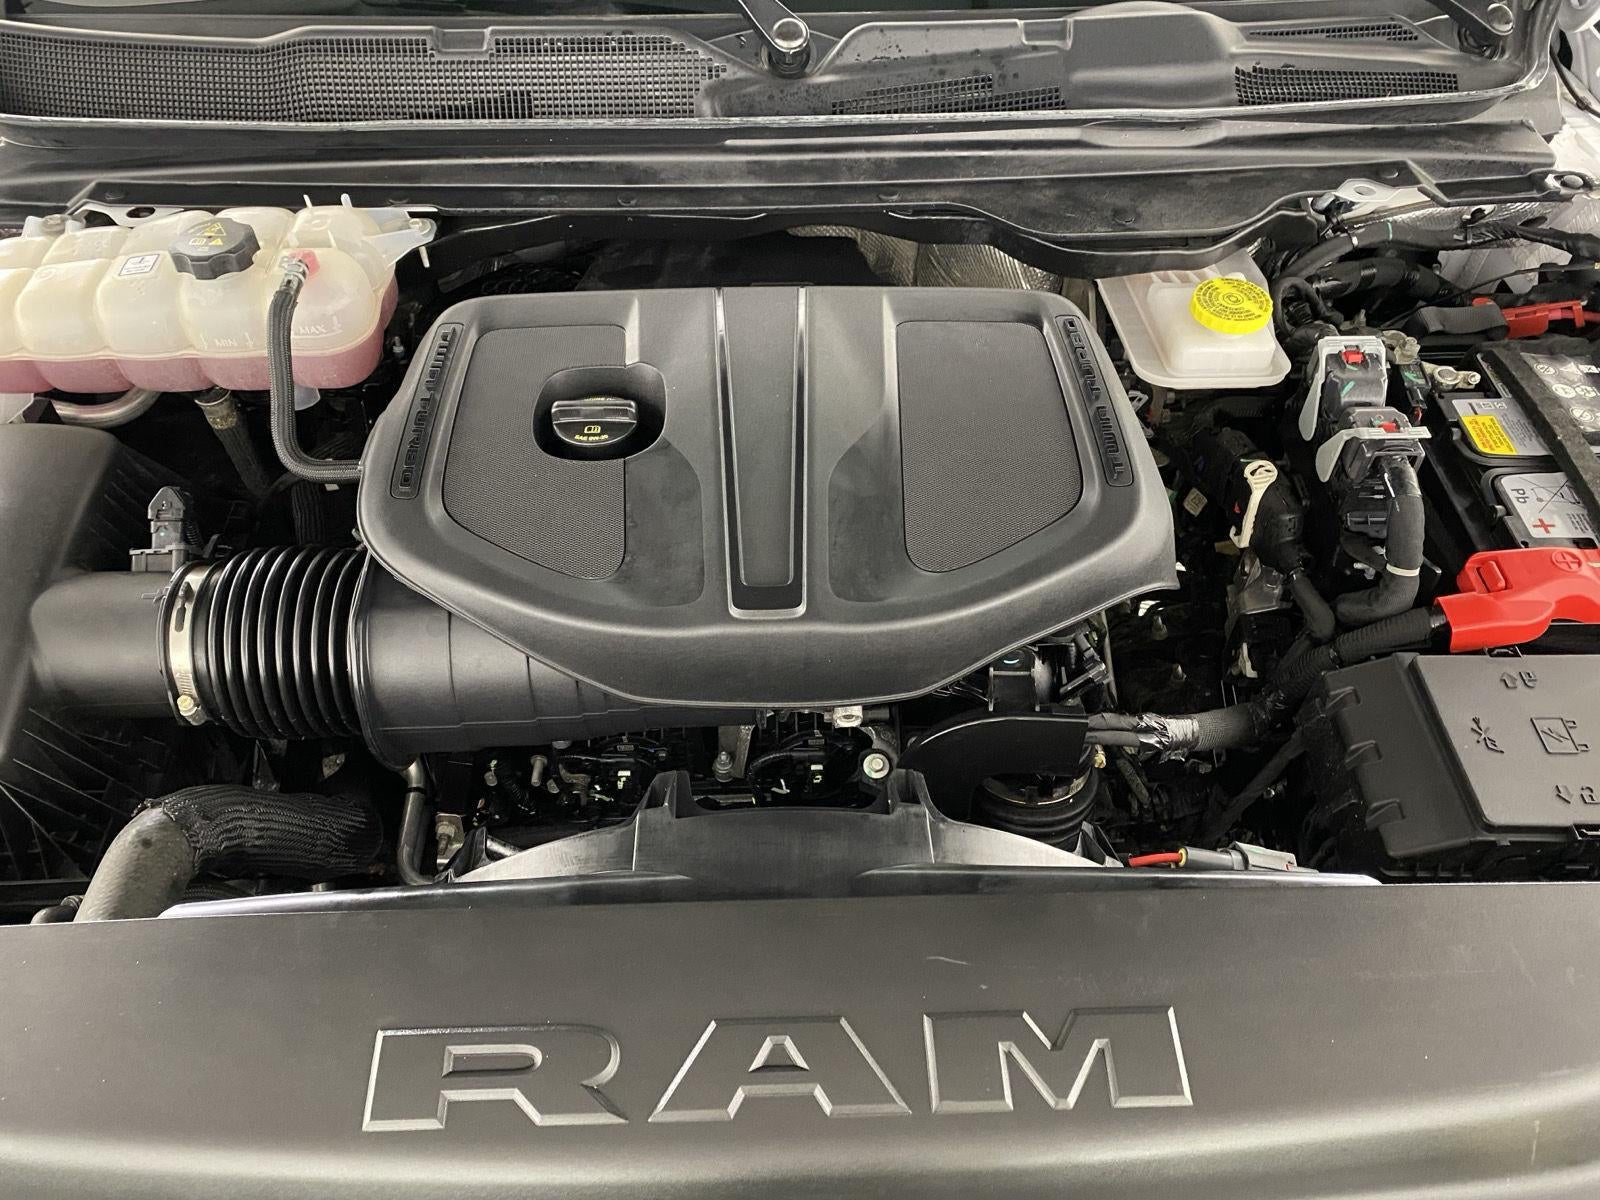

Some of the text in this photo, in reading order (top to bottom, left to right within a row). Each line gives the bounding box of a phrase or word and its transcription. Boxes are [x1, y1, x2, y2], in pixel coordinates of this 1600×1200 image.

[214, 338, 238, 347] MIN
[298, 325, 327, 334] MAX
[1063, 318, 1102, 399] TURBO
[398, 390, 435, 490] TURBO
[1510, 488, 1529, 504] Pb
[361, 1005, 1194, 1132] RAM
